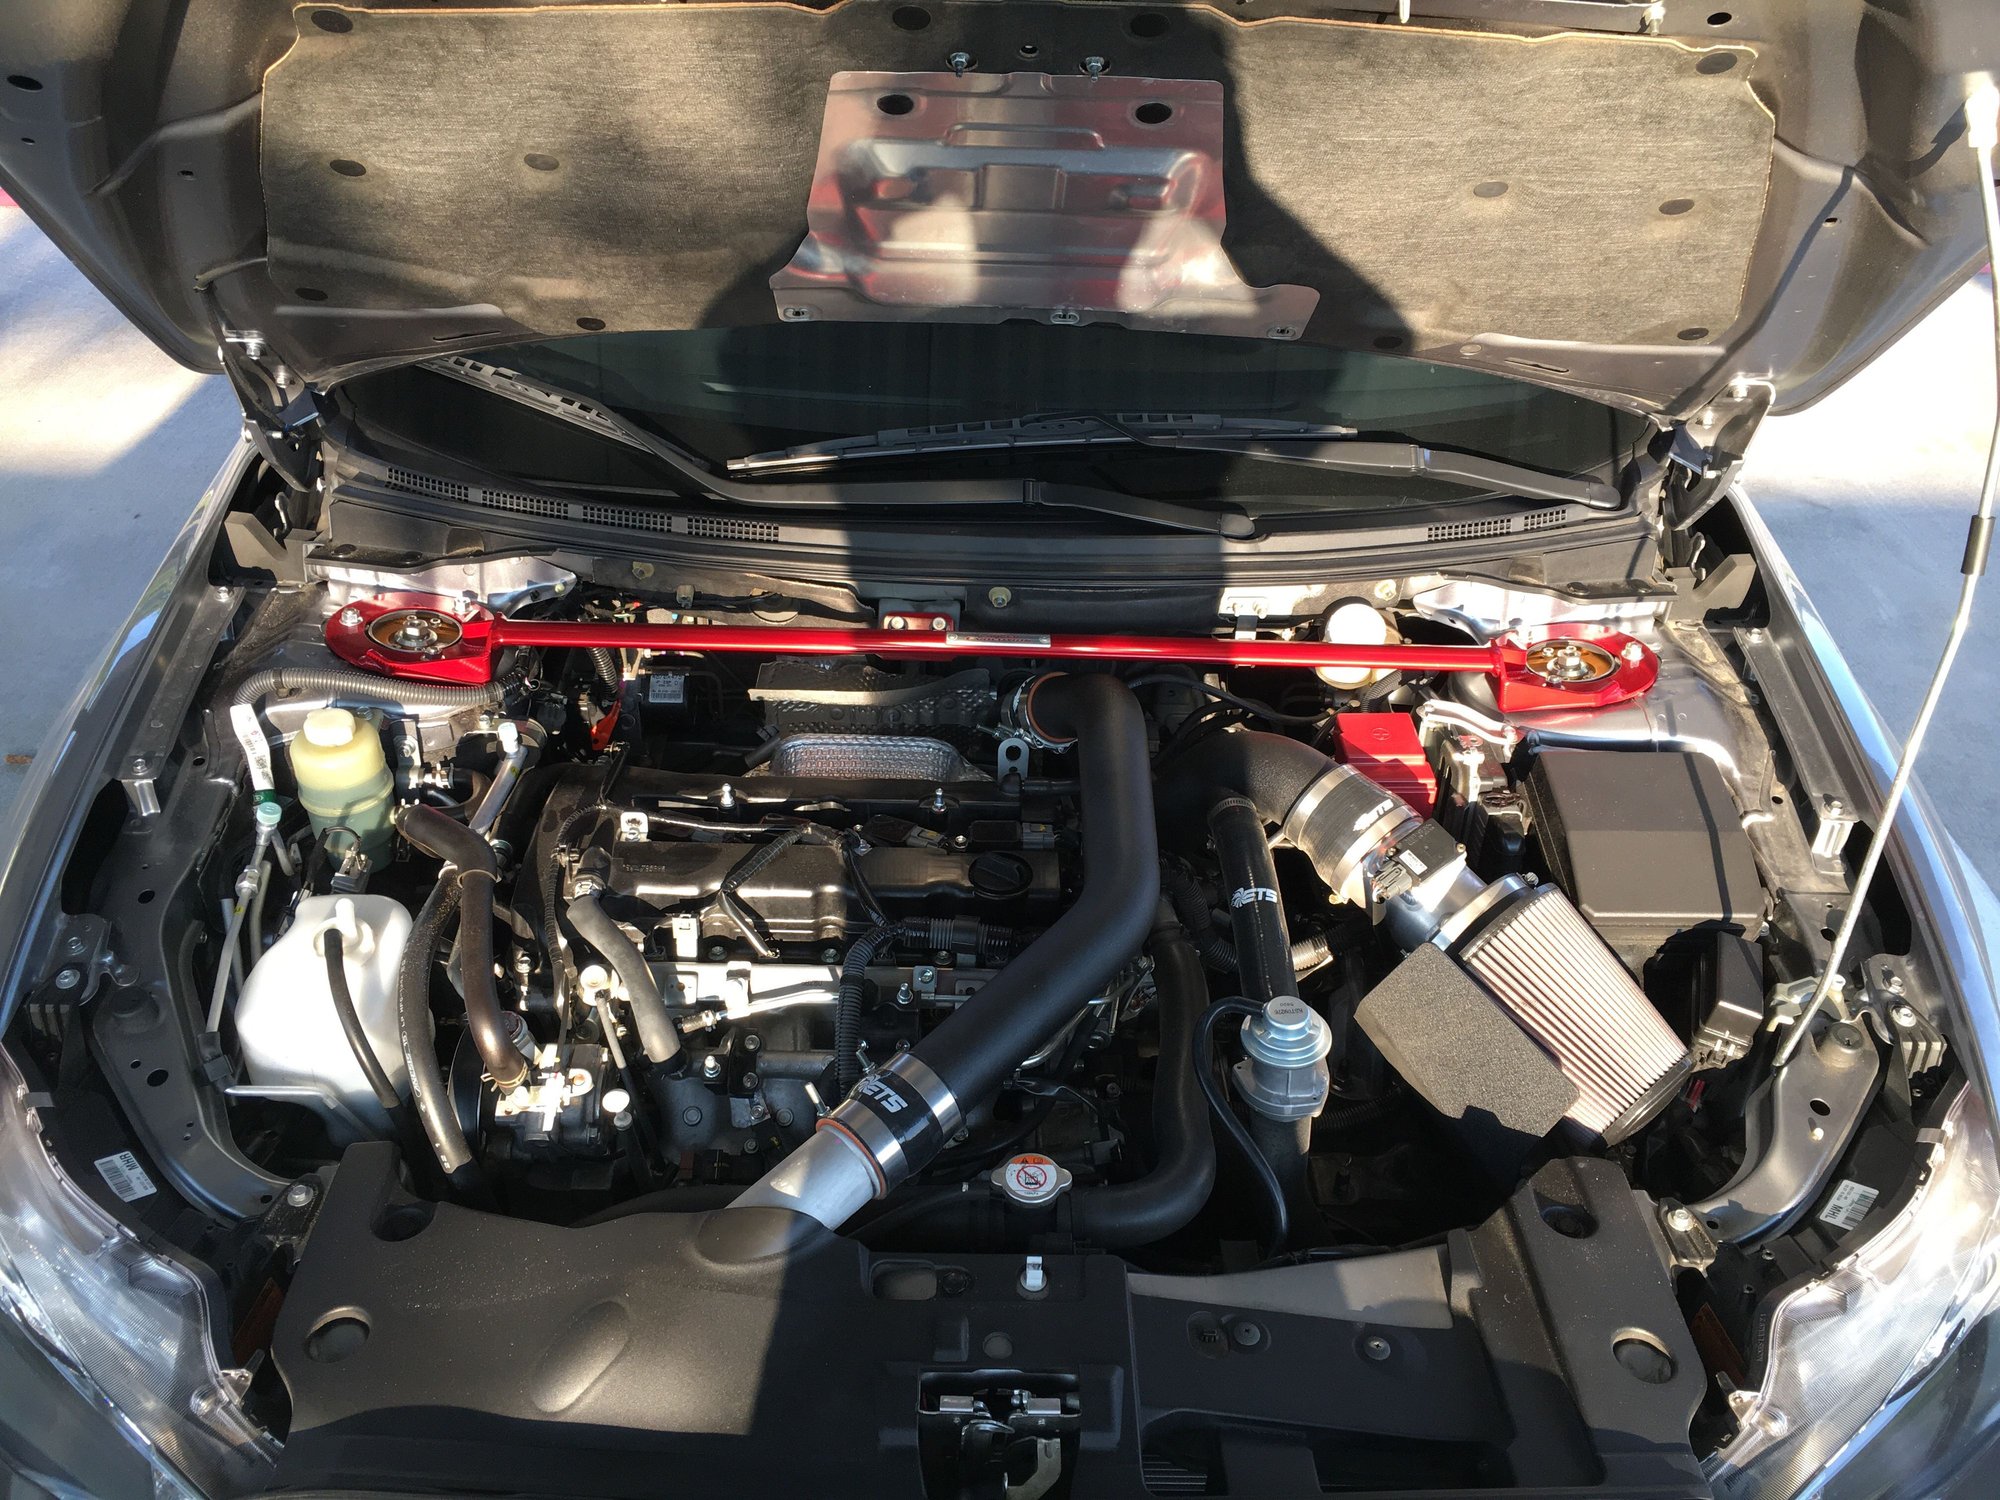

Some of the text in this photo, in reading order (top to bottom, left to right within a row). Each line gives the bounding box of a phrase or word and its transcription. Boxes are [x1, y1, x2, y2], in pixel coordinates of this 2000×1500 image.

[1242, 887, 1278, 904] ETS
[861, 1079, 909, 1113] ETS
[119, 1152, 139, 1171] MHR
[1825, 1203, 1843, 1220] MHL
